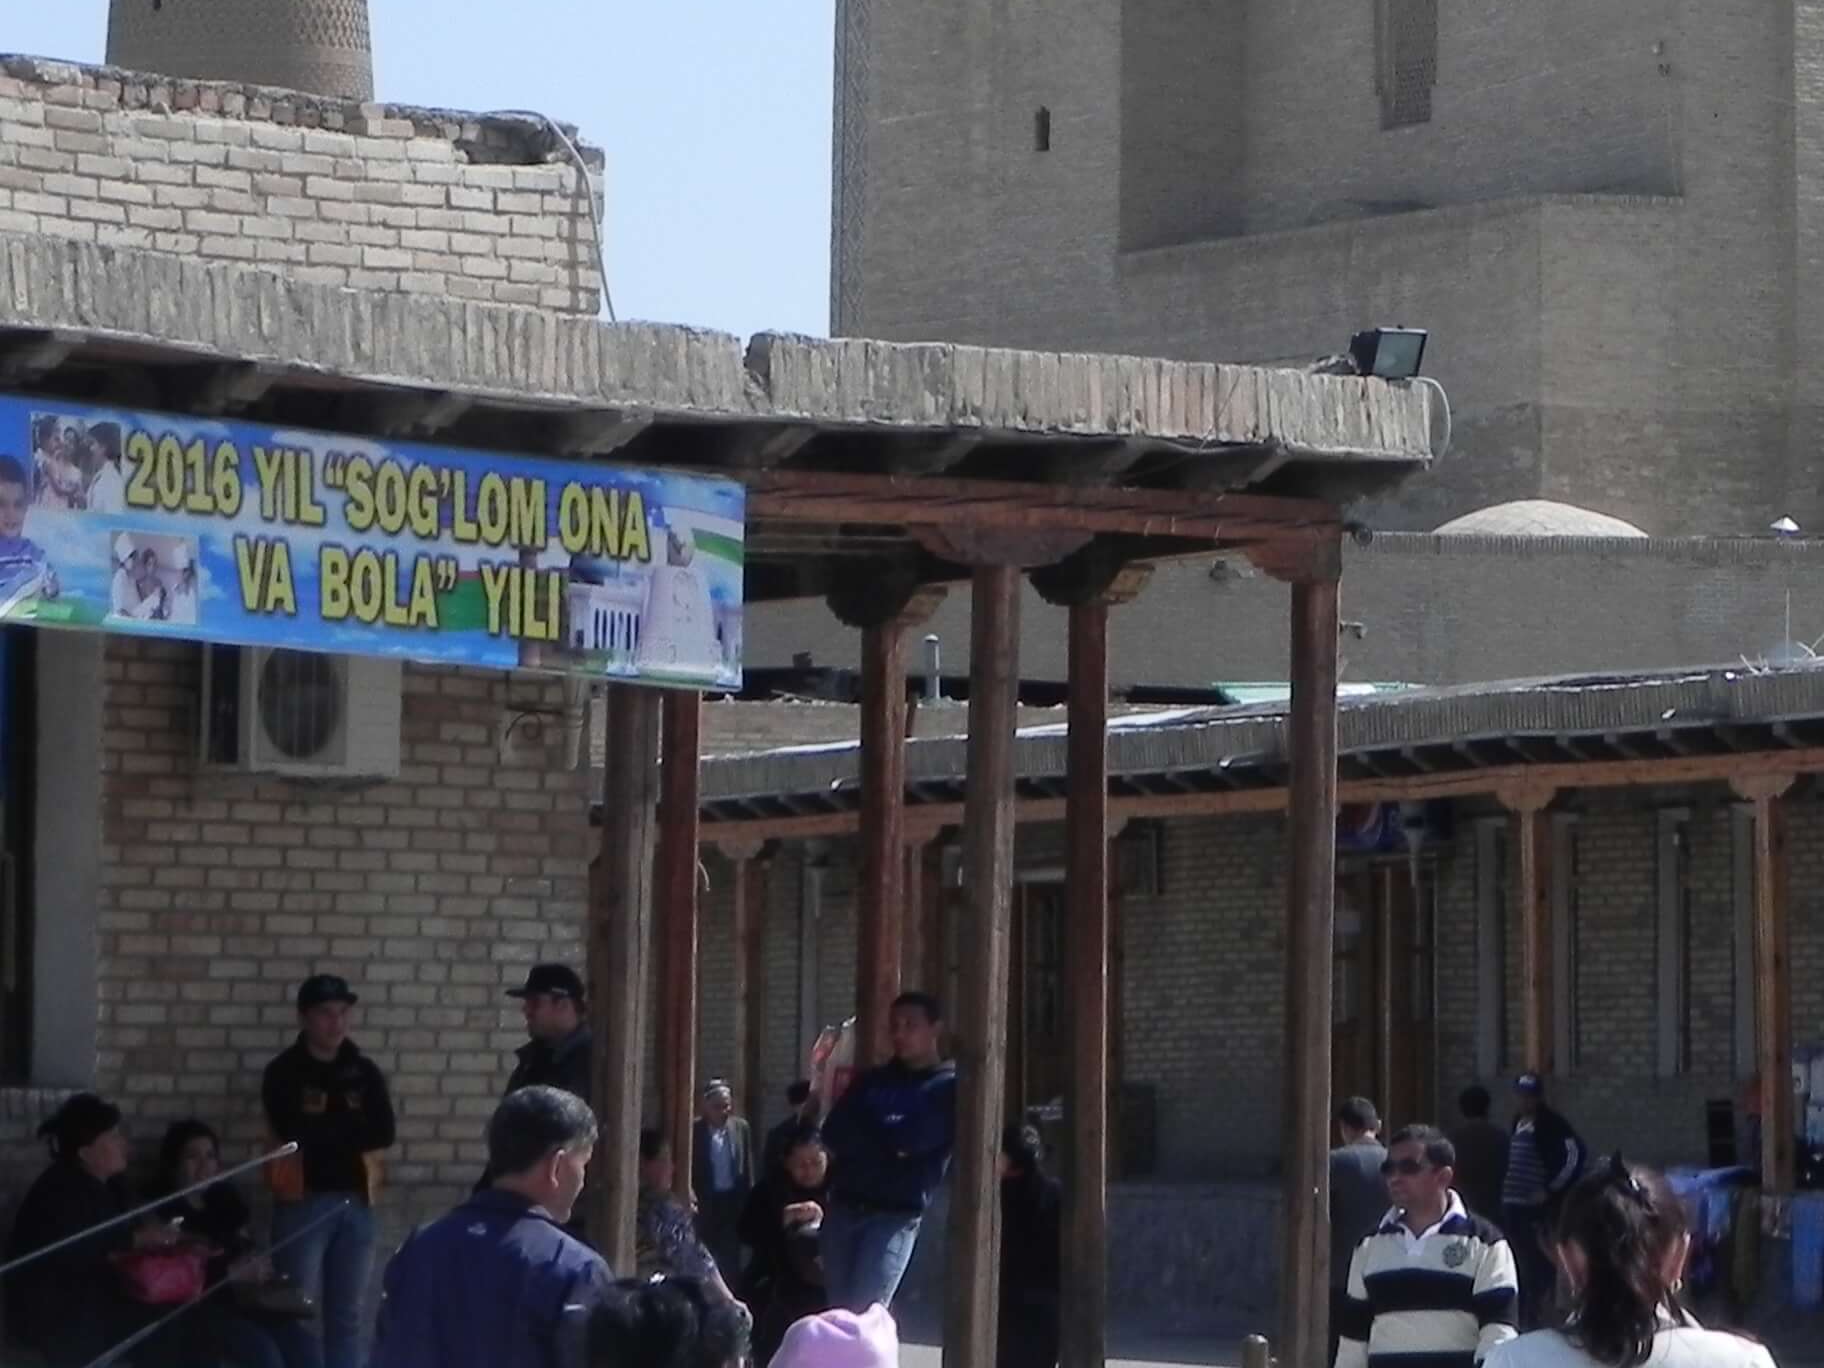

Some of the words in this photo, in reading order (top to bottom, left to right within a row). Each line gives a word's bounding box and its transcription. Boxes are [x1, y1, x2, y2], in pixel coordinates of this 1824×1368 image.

[126, 431, 243, 517] 2016
[252, 444, 325, 525] YIL
[558, 481, 651, 561] ONA
[234, 535, 297, 615] VA
[480, 561, 564, 640] YILI
